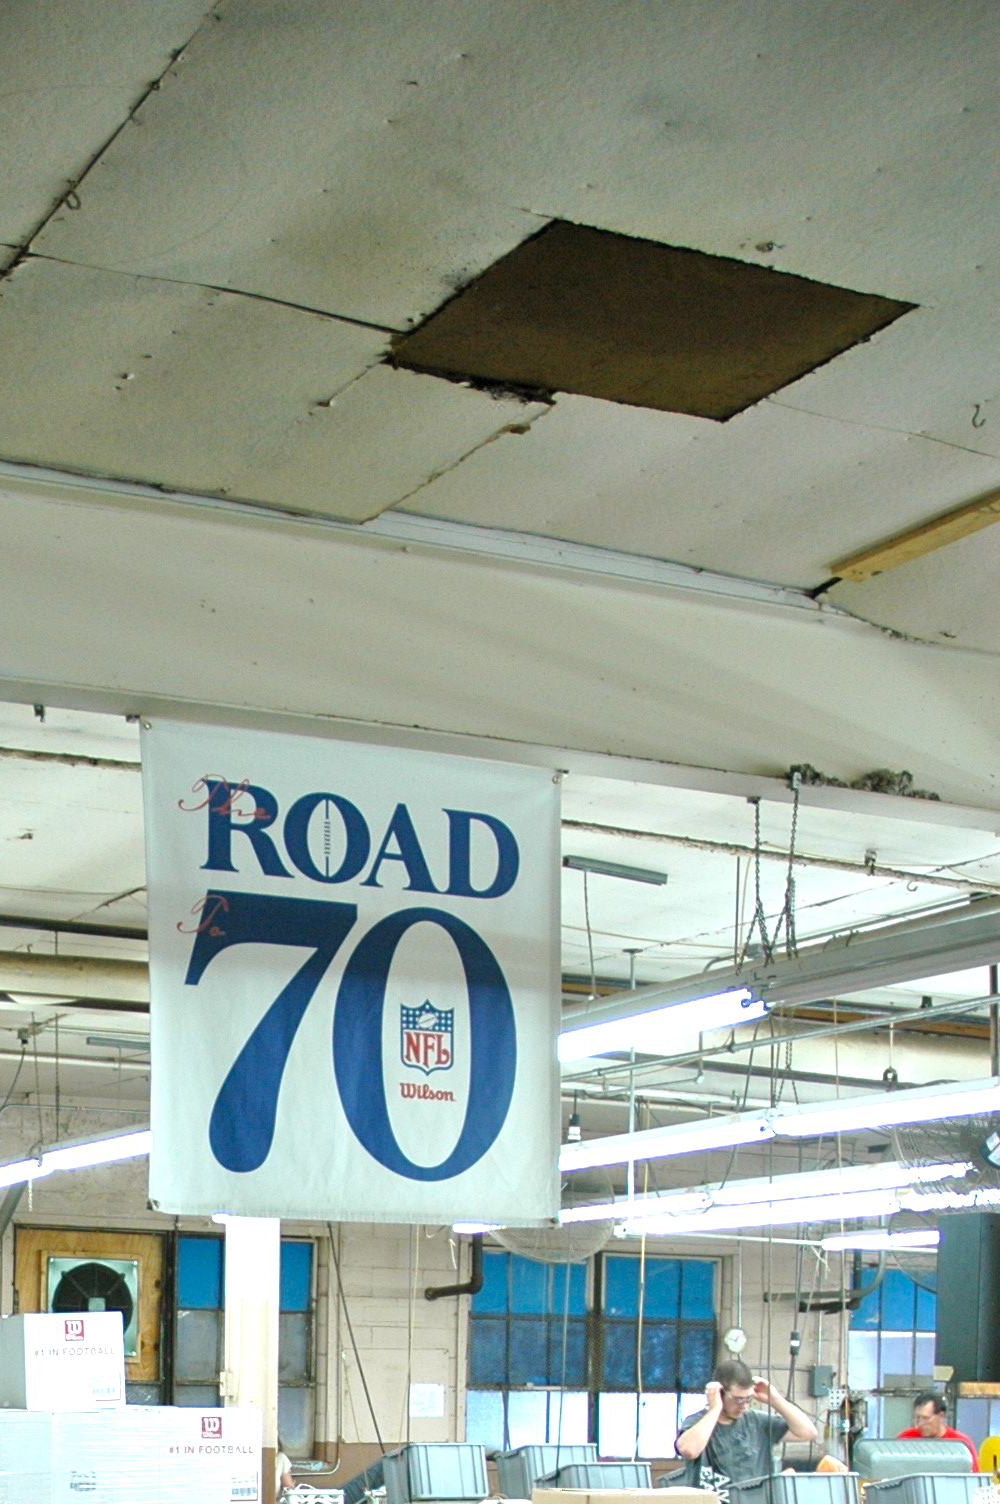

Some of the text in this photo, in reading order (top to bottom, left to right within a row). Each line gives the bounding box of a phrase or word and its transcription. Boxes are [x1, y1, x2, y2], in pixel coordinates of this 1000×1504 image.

[178, 774, 271, 821] The
[200, 779, 520, 898] ROAD
[184, 889, 518, 1182] 70
[403, 1031, 450, 1067] NFL
[399, 1082, 456, 1102] Wilson
[198, 1446, 254, 1454] FOOTBALL
